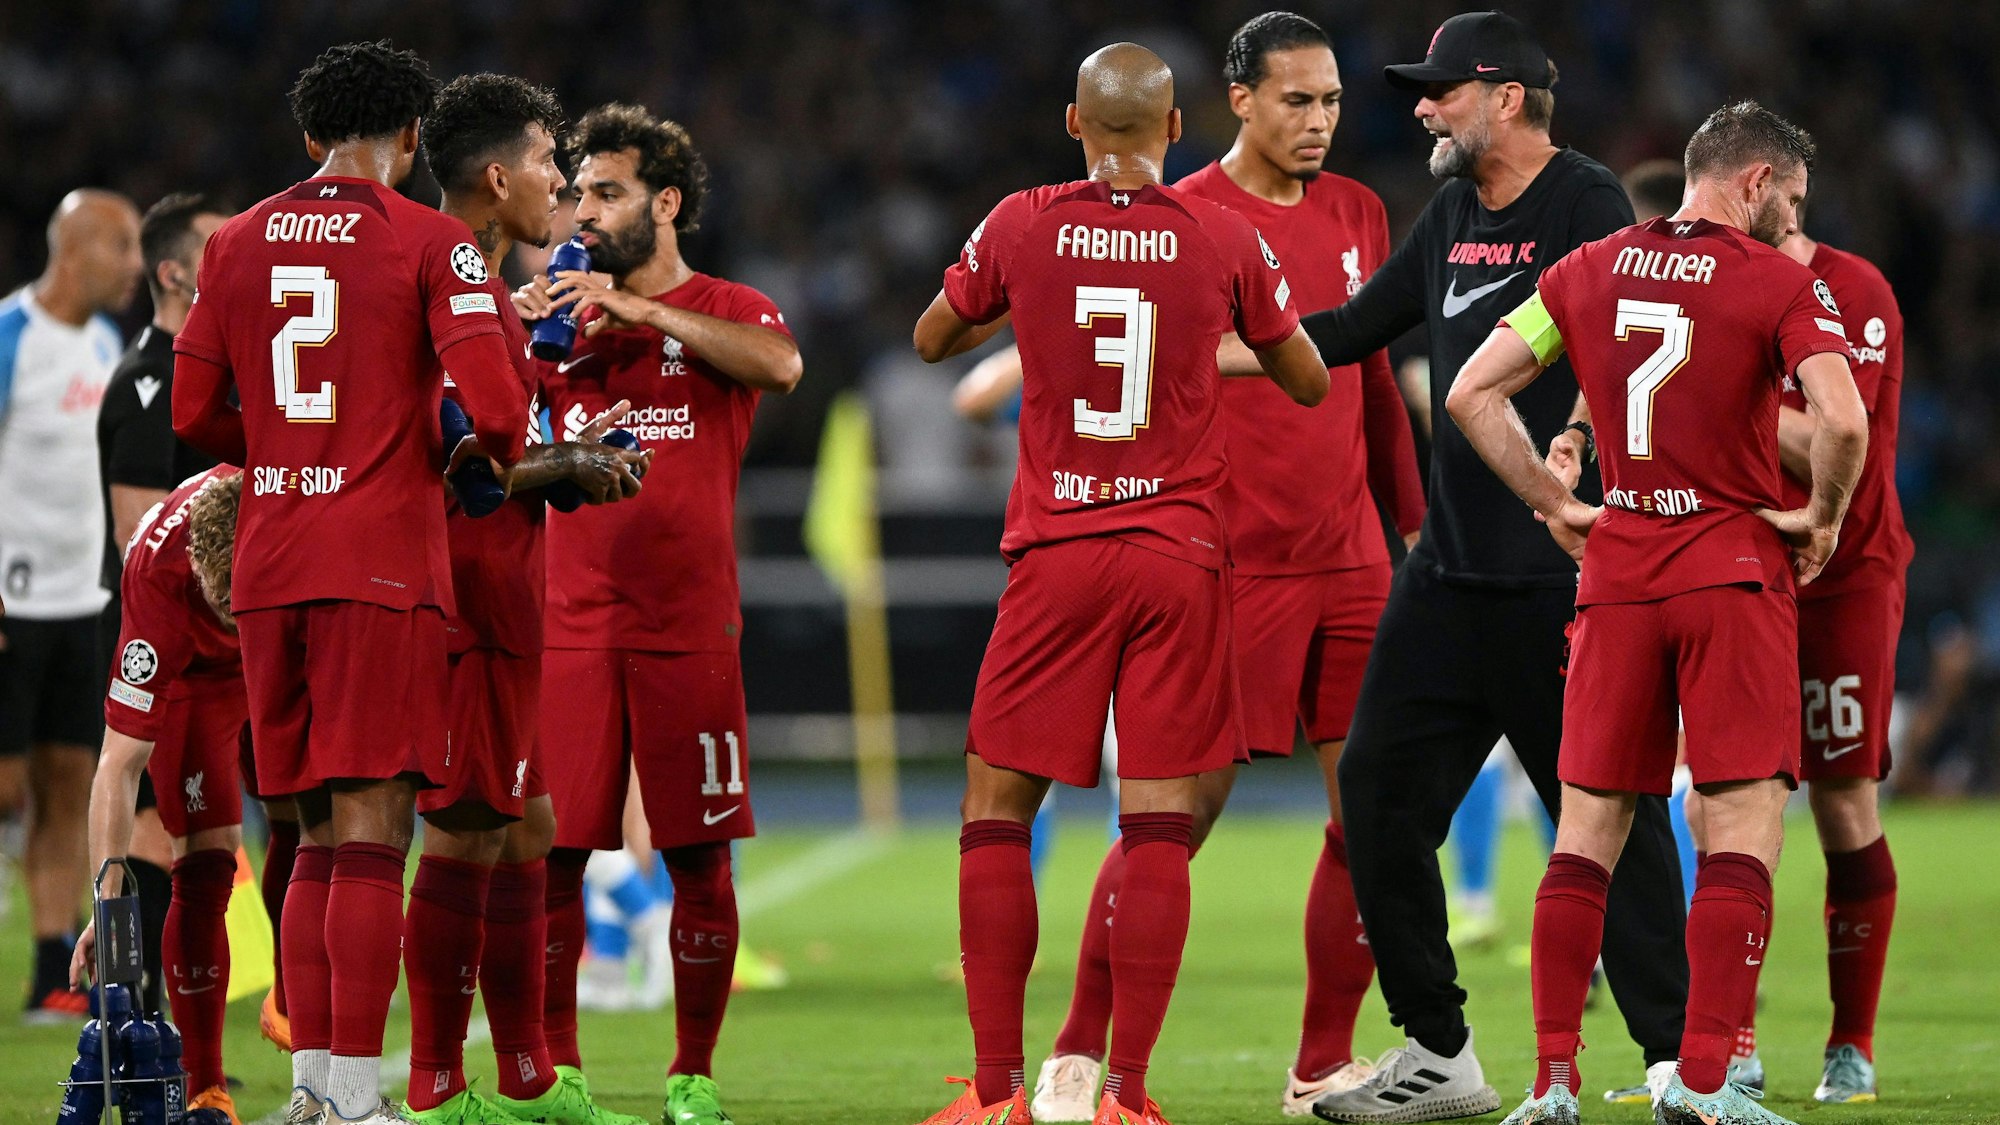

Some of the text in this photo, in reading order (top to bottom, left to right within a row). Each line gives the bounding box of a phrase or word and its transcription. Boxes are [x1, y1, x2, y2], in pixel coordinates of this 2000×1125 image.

[265, 212, 362, 243] GOMEZ
[1056, 224, 1178, 262] FABINHO
[1612, 247, 1717, 285] MILNER
[270, 265, 340, 423] 2
[1073, 286, 1158, 441] 3
[1614, 298, 1695, 461] 7
[253, 465, 290, 496] SIDE
[1052, 470, 1098, 504] SIDE
[1653, 488, 1705, 516] SIDE
[1802, 674, 1864, 741] 26
[699, 730, 744, 796] 11
